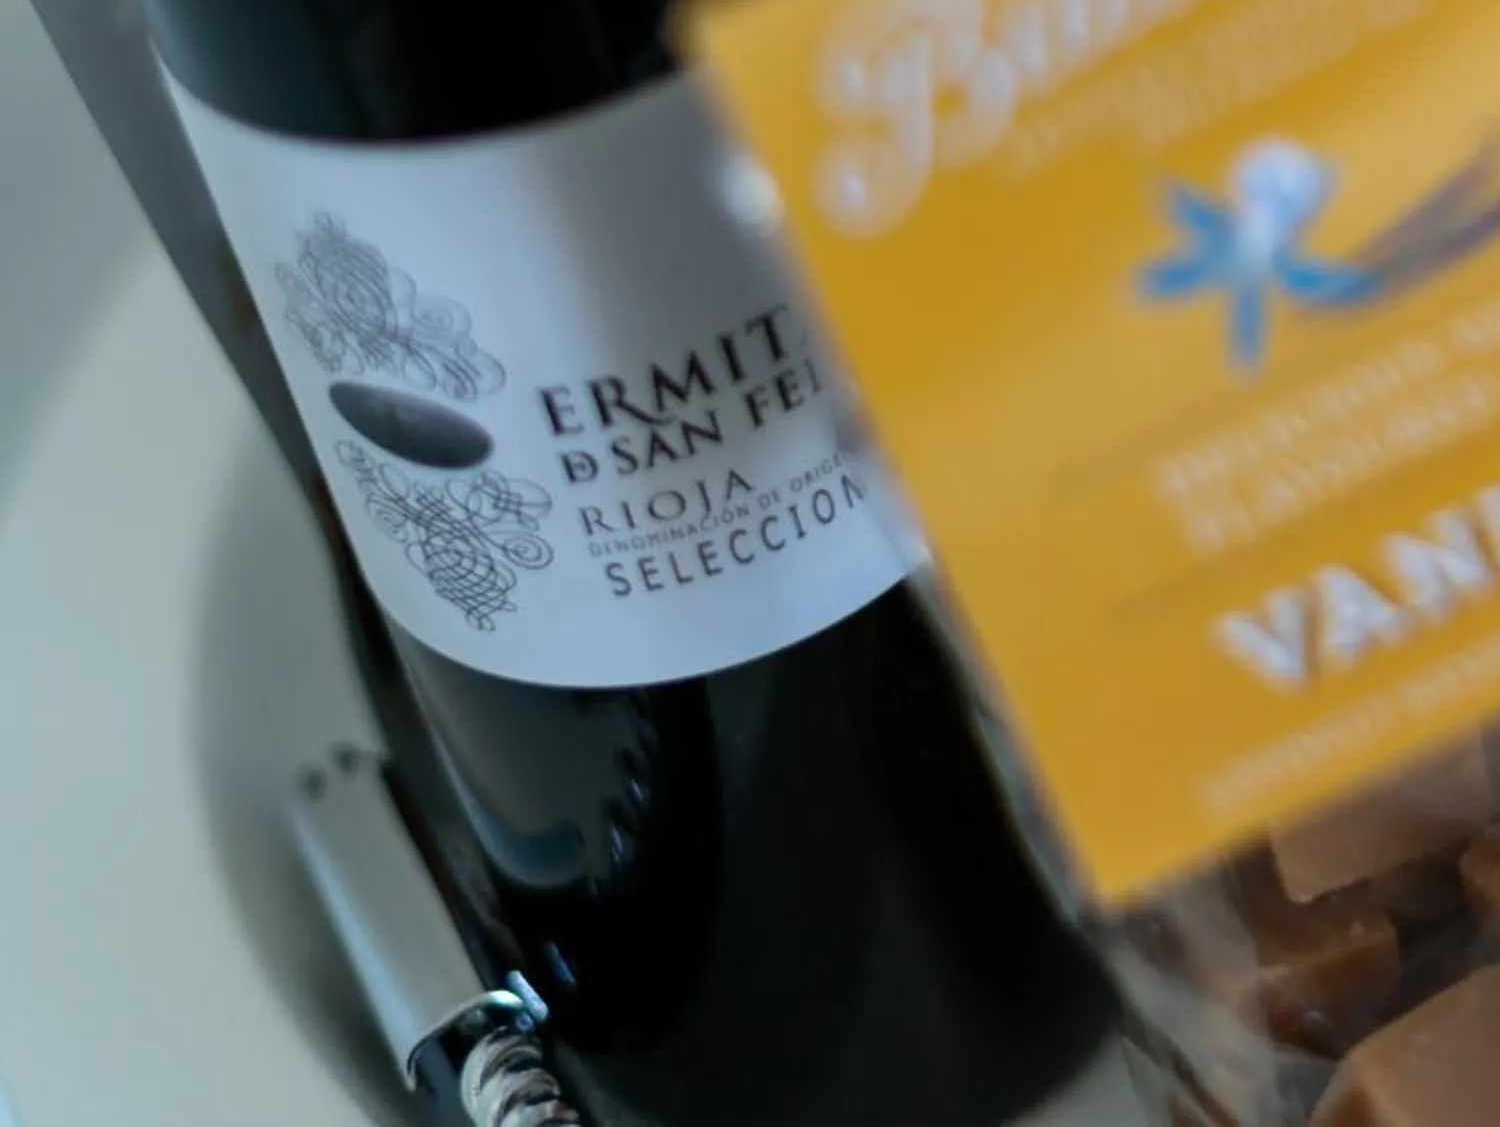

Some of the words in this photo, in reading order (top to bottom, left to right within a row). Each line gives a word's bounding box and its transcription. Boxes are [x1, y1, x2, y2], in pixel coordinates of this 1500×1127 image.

[537, 303, 800, 437] ERMIT
[610, 410, 724, 475] SAN
[578, 469, 753, 536] RIOJA
